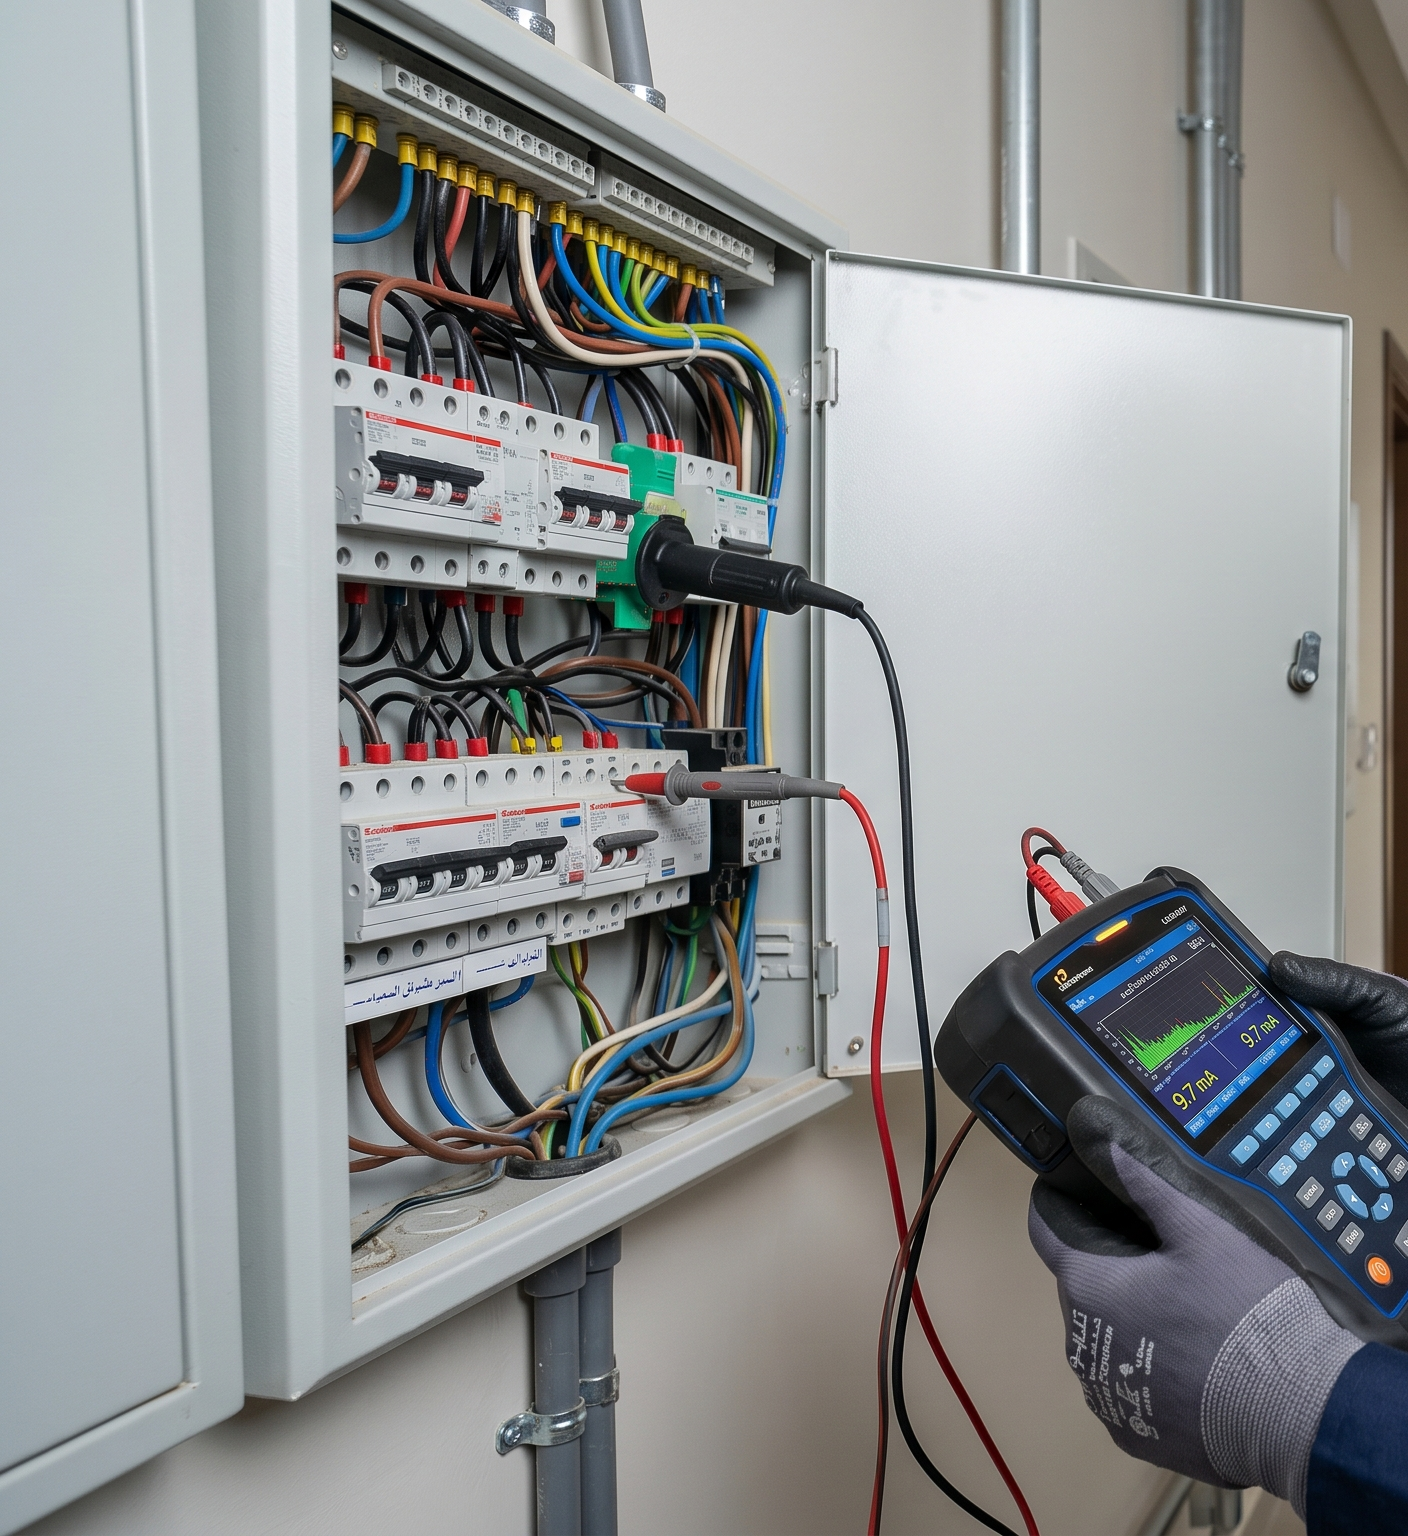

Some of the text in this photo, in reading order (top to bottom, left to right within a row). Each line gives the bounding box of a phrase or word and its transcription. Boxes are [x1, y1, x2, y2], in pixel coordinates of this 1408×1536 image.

[1240, 1024, 1262, 1048] 9.7
[1259, 1014, 1280, 1035] mA
[1171, 1081, 1198, 1111] 9.7
[1195, 1069, 1219, 1093] mA
